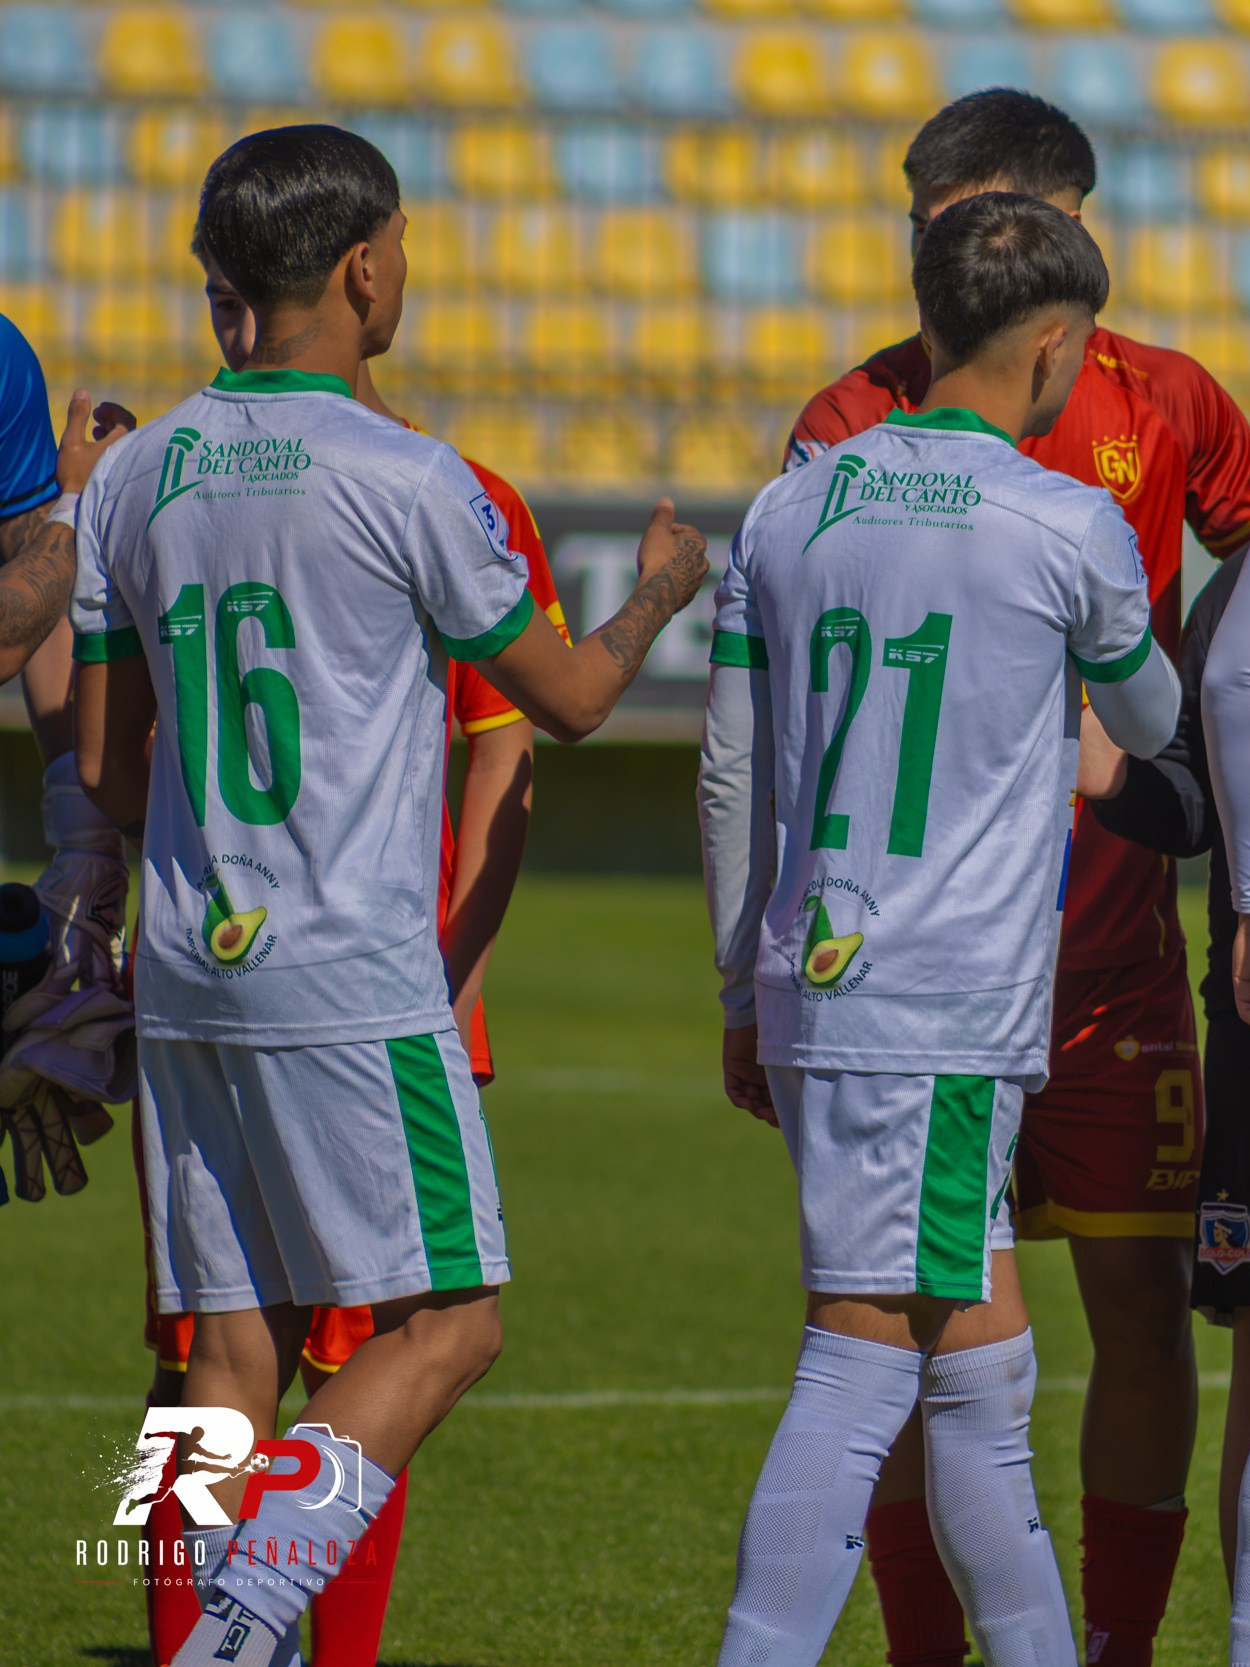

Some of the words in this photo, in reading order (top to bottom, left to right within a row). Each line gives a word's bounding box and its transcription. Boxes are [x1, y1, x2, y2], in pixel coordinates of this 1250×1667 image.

[199, 438, 305, 458] SANDOVAL
[197, 457, 235, 475] DEL
[238, 453, 312, 474] CANTO
[247, 472, 299, 484] ASOCIADOS
[863, 468, 976, 489] SANDOVAL
[193, 490, 241, 500] Auditores
[245, 487, 306, 498] Tributarios
[859, 484, 897, 503] DEL
[901, 489, 982, 507] CANTO
[912, 505, 968, 515] ASOCIADOS
[852, 515, 904, 526] Auditores
[907, 517, 974, 531] Tributarios
[158, 581, 301, 828] 16
[808, 607, 953, 858] 21
[221, 853, 253, 870] DOÑA
[254, 862, 280, 890] ANNY
[826, 877, 859, 896] DOÑA
[859, 890, 880, 917] ANNY
[210, 967, 233, 980] ALTO
[234, 934, 278, 977] VALLENAR
[803, 989, 823, 1002] ALTO
[825, 960, 873, 1000] VALLENAR
[1155, 1069, 1195, 1163] 9
